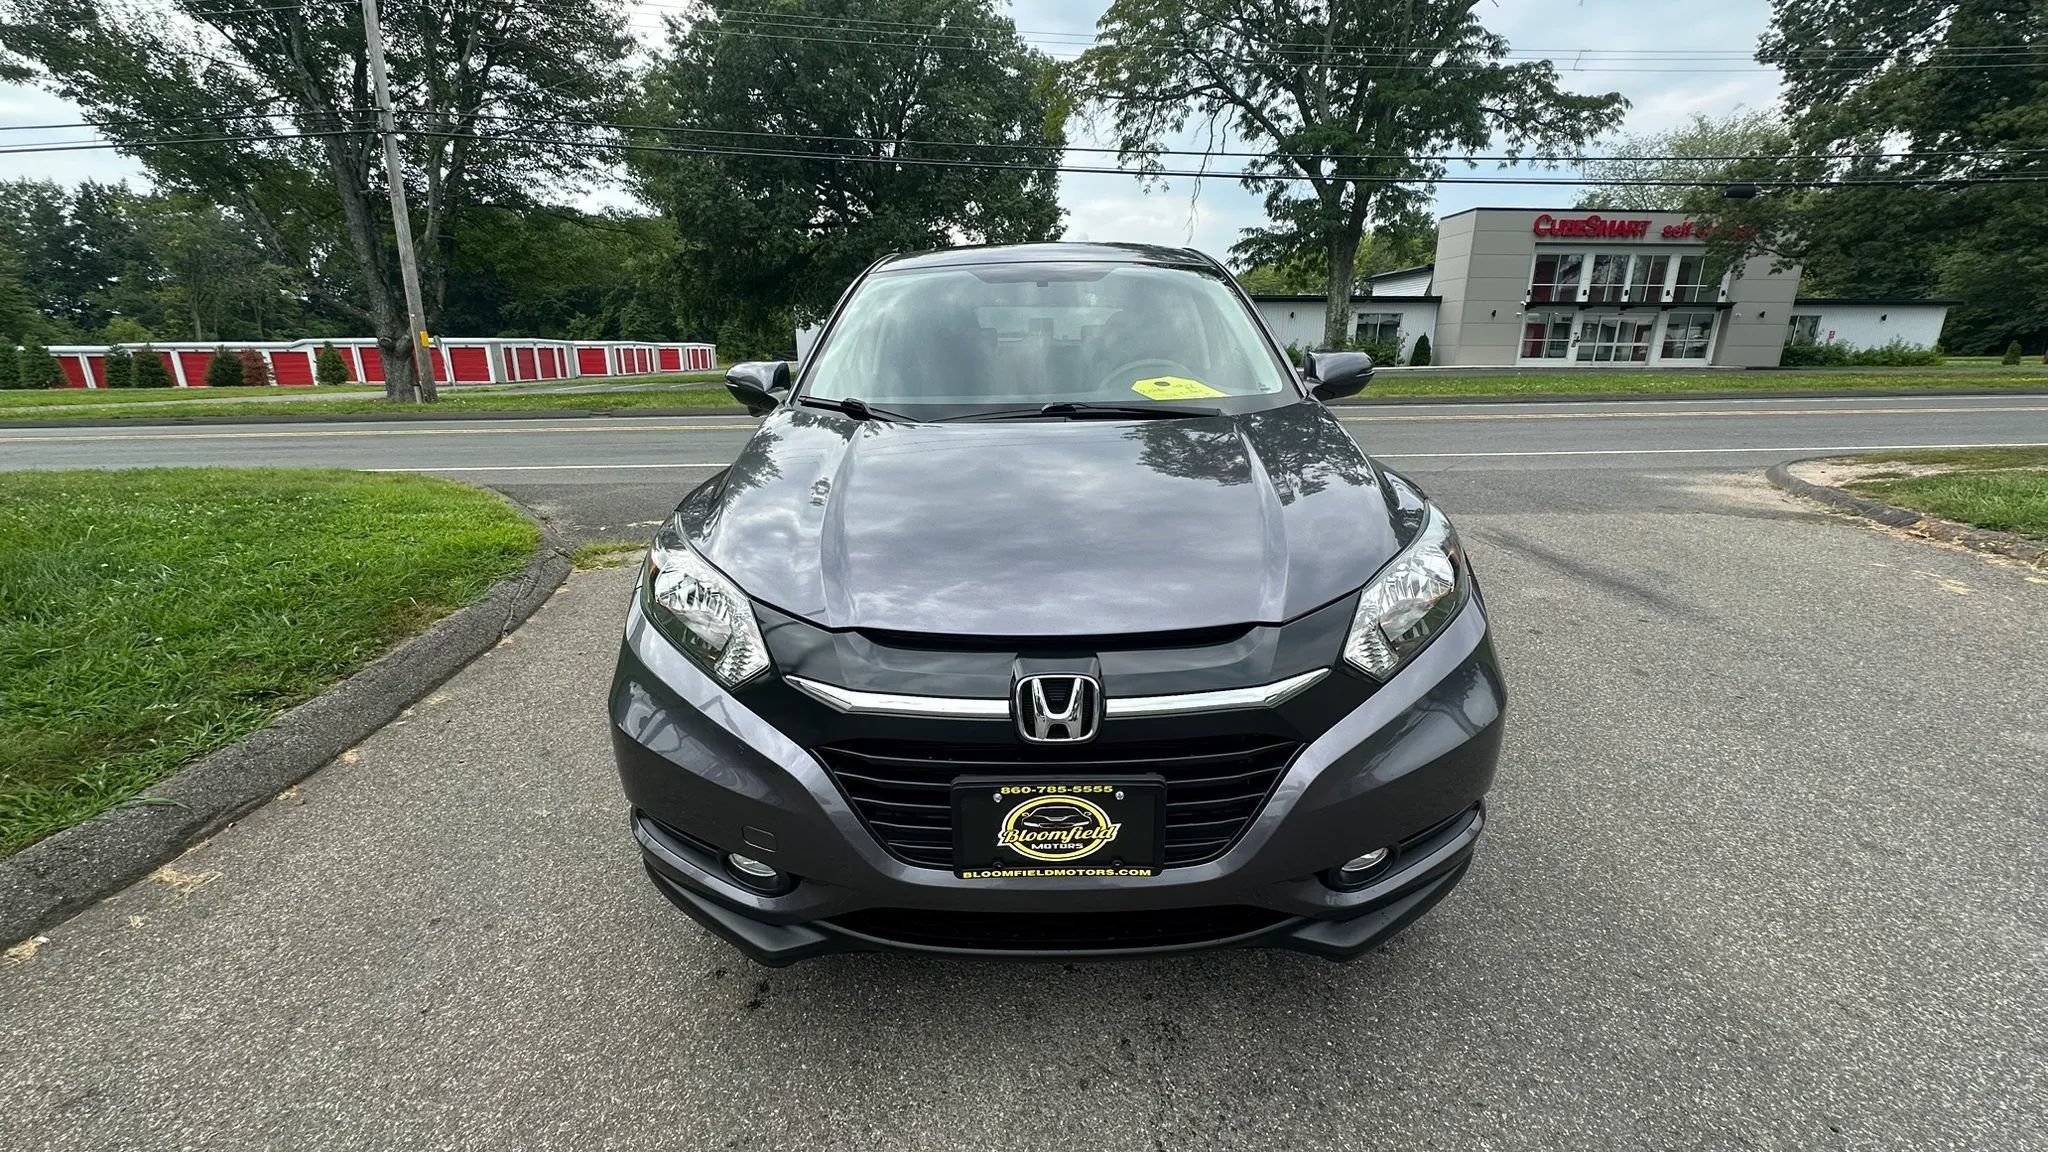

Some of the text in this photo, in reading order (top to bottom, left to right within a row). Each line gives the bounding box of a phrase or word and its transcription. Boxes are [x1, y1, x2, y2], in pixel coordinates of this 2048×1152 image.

[1662, 222, 1696, 239] self
[1001, 785, 1113, 794] 860-785-5555
[1002, 826, 1115, 843] Bloomfield
[962, 868, 1152, 878] BLOOMFIELDMOTORS.COM
